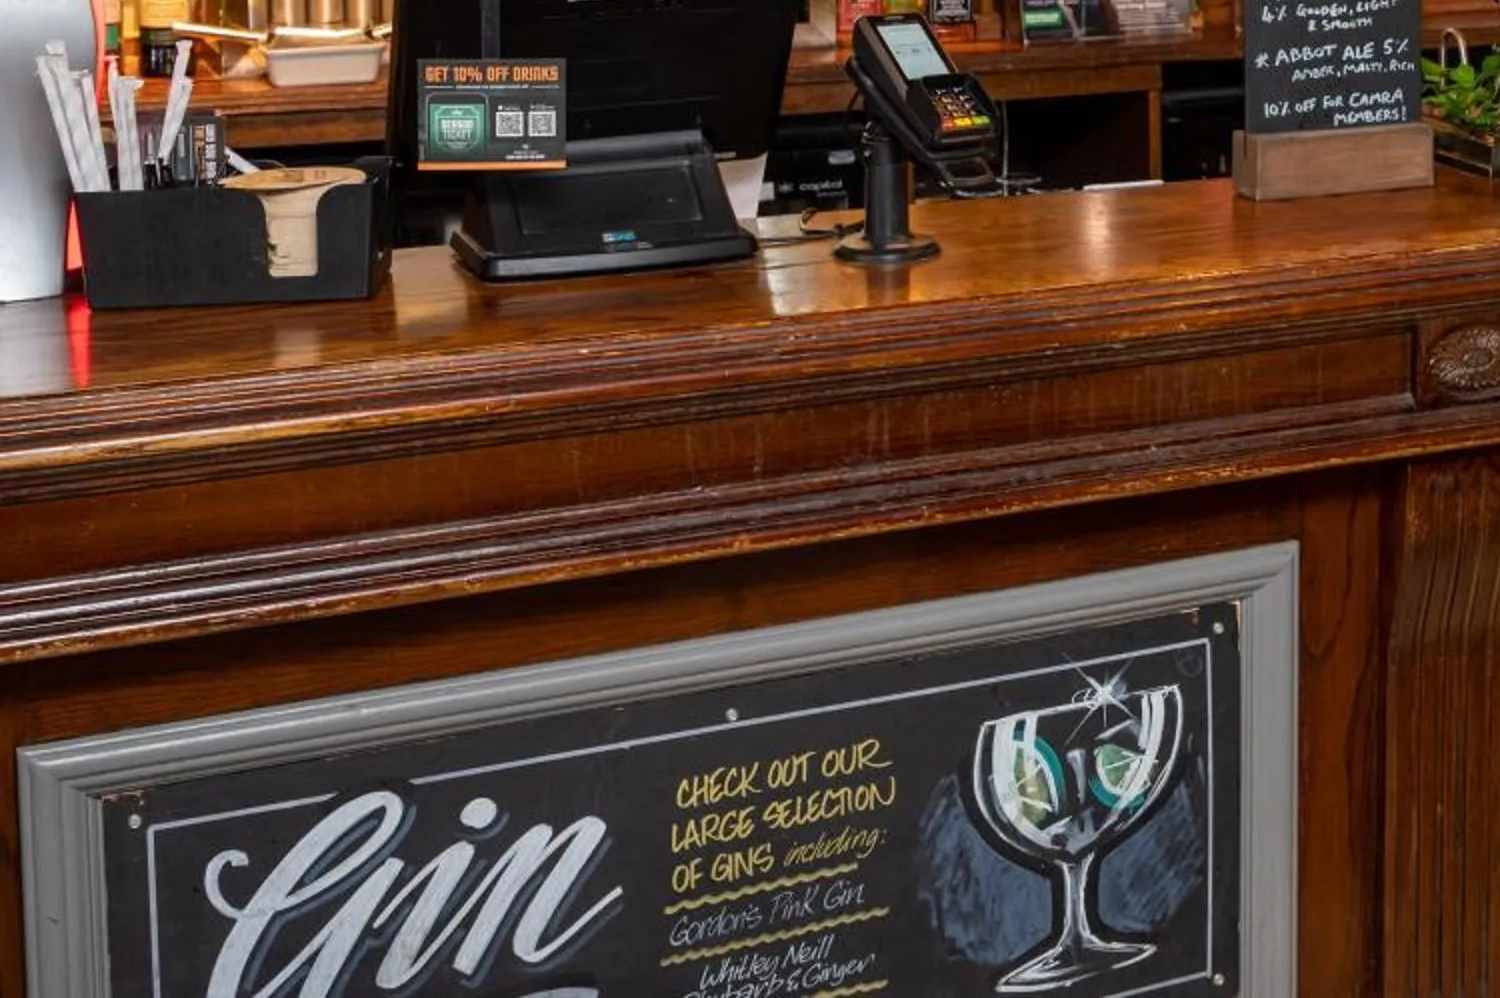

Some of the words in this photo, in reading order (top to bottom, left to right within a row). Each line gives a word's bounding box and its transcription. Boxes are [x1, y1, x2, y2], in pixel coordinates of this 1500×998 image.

[1262, 5, 1288, 24] 4%
[1321, 17, 1373, 31] SMOOTH
[1275, 45, 1337, 66] ABBOT
[1342, 42, 1375, 61] ALE
[1383, 38, 1409, 55] 5%
[1389, 59, 1415, 72] RICH
[425, 66, 449, 82] GET
[453, 66, 484, 82] 10%
[486, 66, 511, 82] OFF
[512, 66, 560, 82] DRINKS
[1264, 102, 1291, 118] 10%
[1295, 98, 1317, 113] OFF
[1350, 88, 1403, 107] CAMRA
[1333, 105, 1408, 126] MEMBERS!
[676, 762, 762, 809] CHECK
[767, 751, 816, 789] OUT
[822, 739, 893, 777] OUR
[671, 806, 755, 853] LARGE
[762, 776, 896, 830] SELECTION
[672, 858, 704, 893] OF
[711, 843, 774, 882] GINS
[784, 826, 888, 866] including:
[204, 791, 623, 998] Gin
[669, 904, 762, 946] Gordon's
[824, 880, 865, 911] Gin
[699, 954, 780, 989] Whitley
[782, 934, 834, 969] Neill
[801, 954, 876, 989] Ginger
